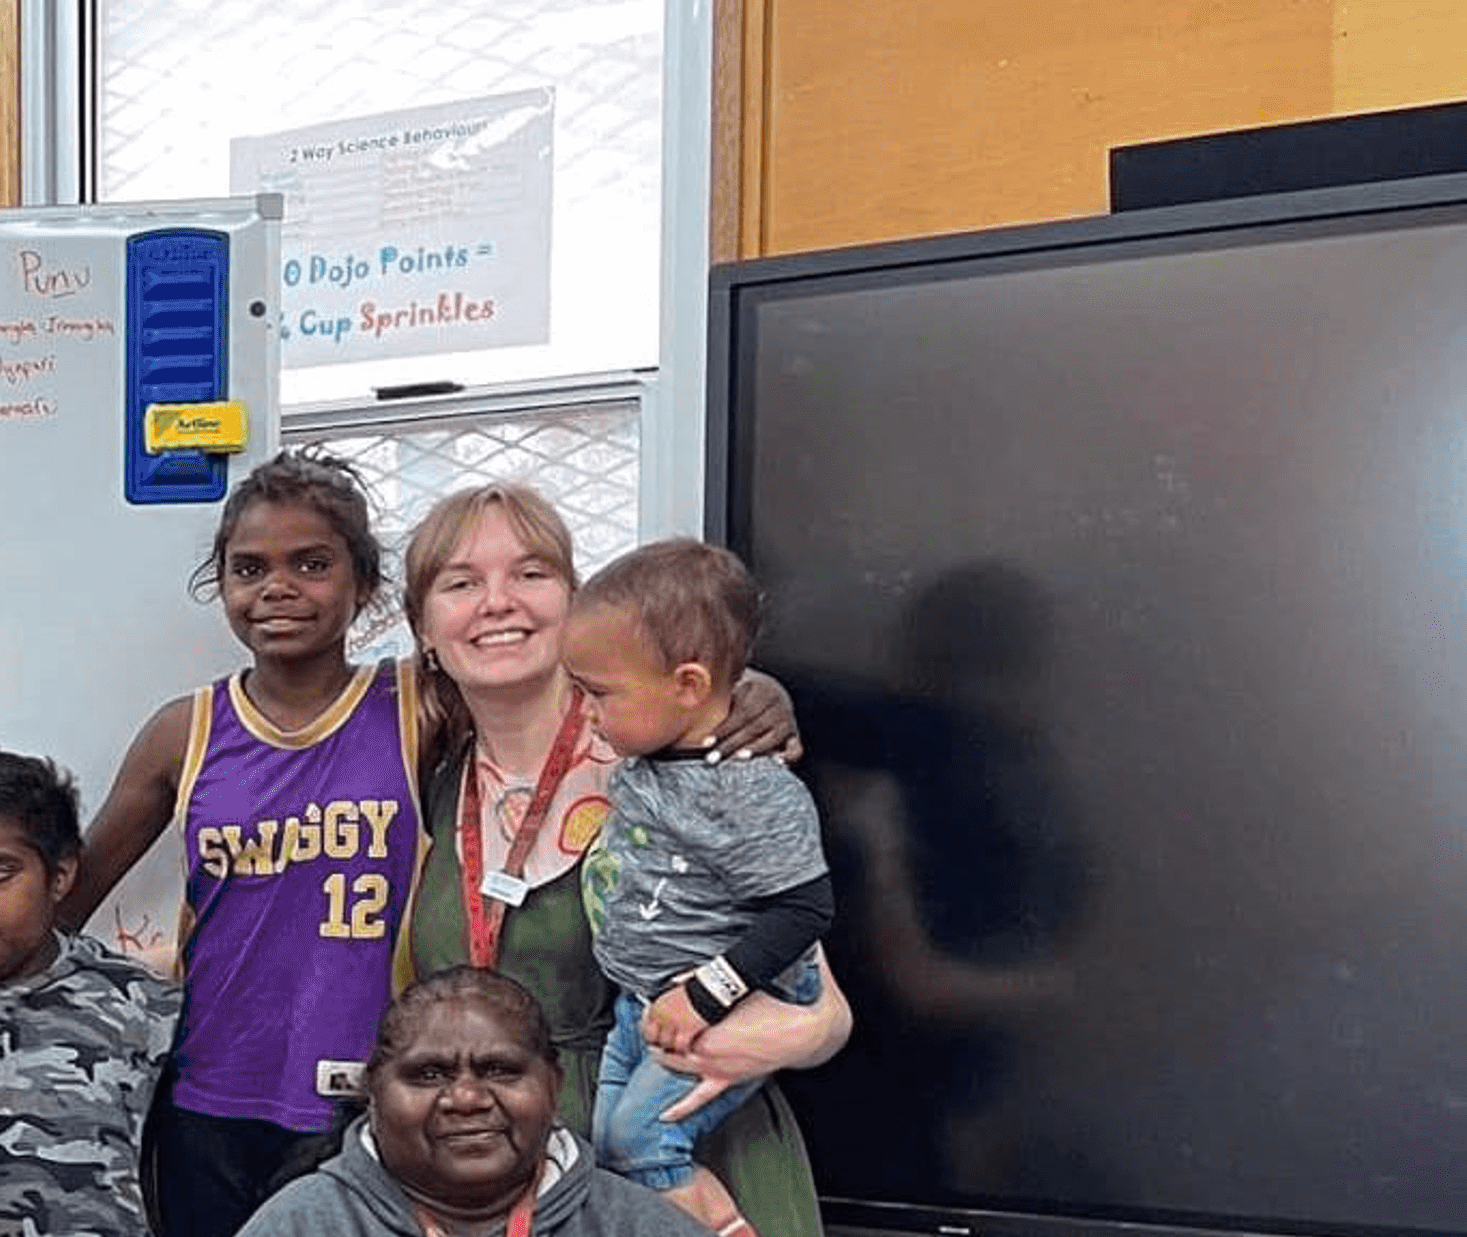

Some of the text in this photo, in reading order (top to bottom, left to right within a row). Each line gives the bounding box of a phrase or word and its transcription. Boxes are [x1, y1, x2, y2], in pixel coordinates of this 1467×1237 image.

[338, 135, 399, 155] Science
[309, 255, 369, 288] Dojo
[380, 246, 468, 276] Points
[299, 309, 352, 343] Cup
[360, 292, 495, 338] Sprinkles
[197, 800, 399, 879] SWGGY
[319, 873, 389, 940] 12
